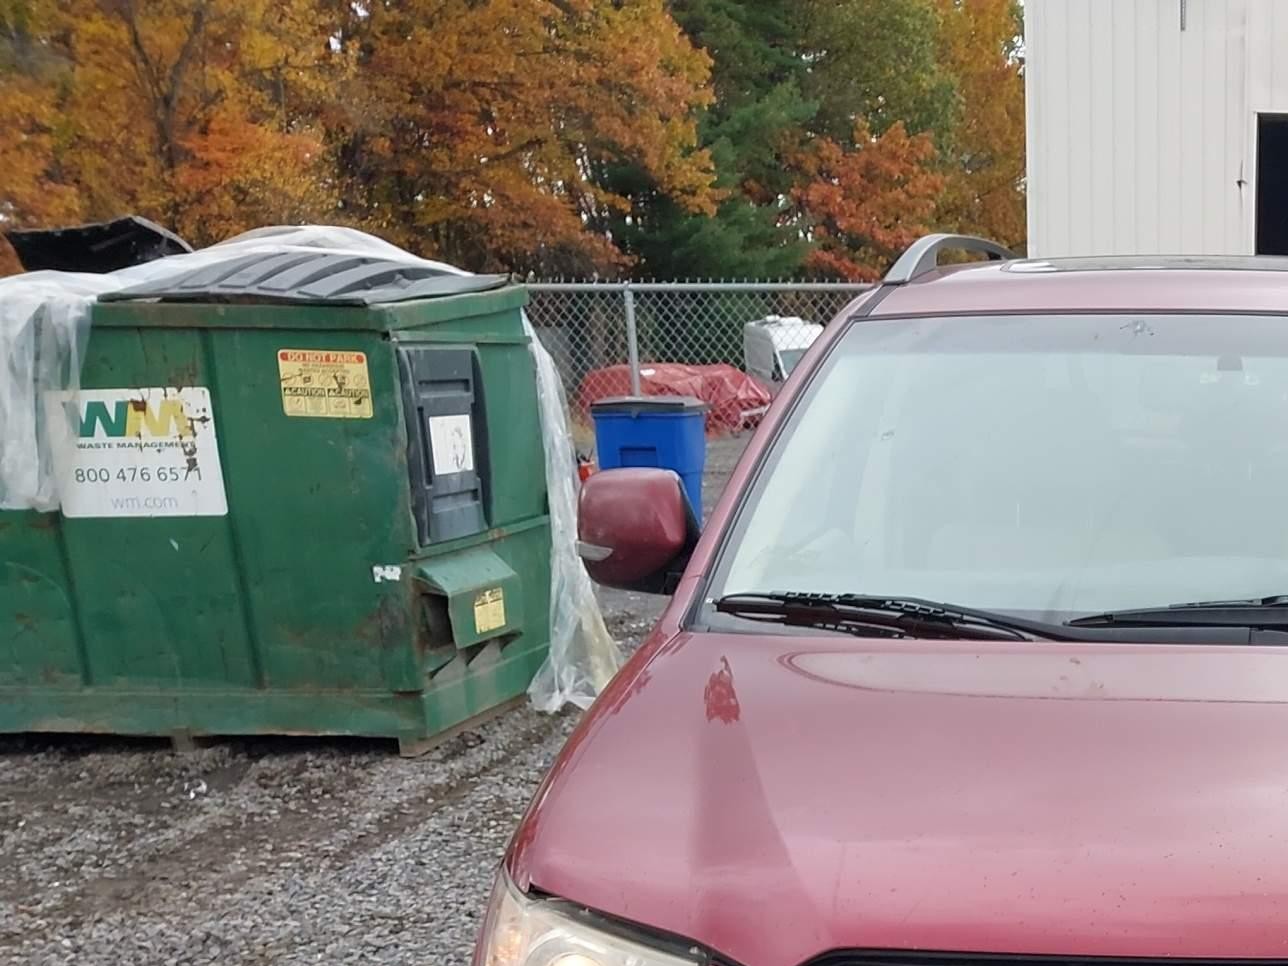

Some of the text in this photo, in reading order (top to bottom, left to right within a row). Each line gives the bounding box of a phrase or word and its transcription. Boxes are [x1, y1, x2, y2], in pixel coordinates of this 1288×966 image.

[288, 352, 305, 361] DO
[307, 353, 327, 362] NOT
[62, 400, 192, 437] WM
[75, 466, 202, 483] 800 476 6571
[112, 497, 179, 509] wm.com
